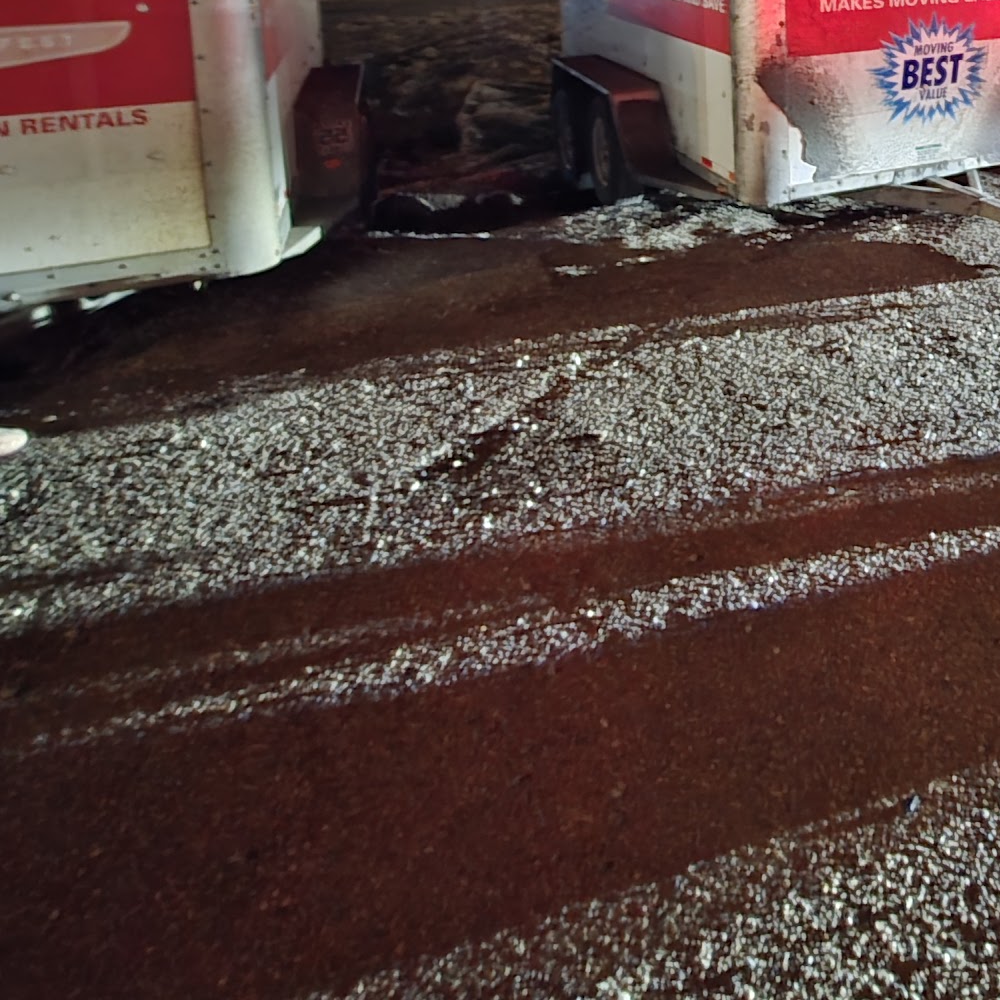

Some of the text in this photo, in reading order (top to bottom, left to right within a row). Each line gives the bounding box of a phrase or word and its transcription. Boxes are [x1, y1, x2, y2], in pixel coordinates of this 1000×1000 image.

[914, 41, 954, 56] MOVING
[901, 53, 964, 91] BEST
[919, 86, 948, 101] VALUE
[20, 108, 148, 135] RENTALS
